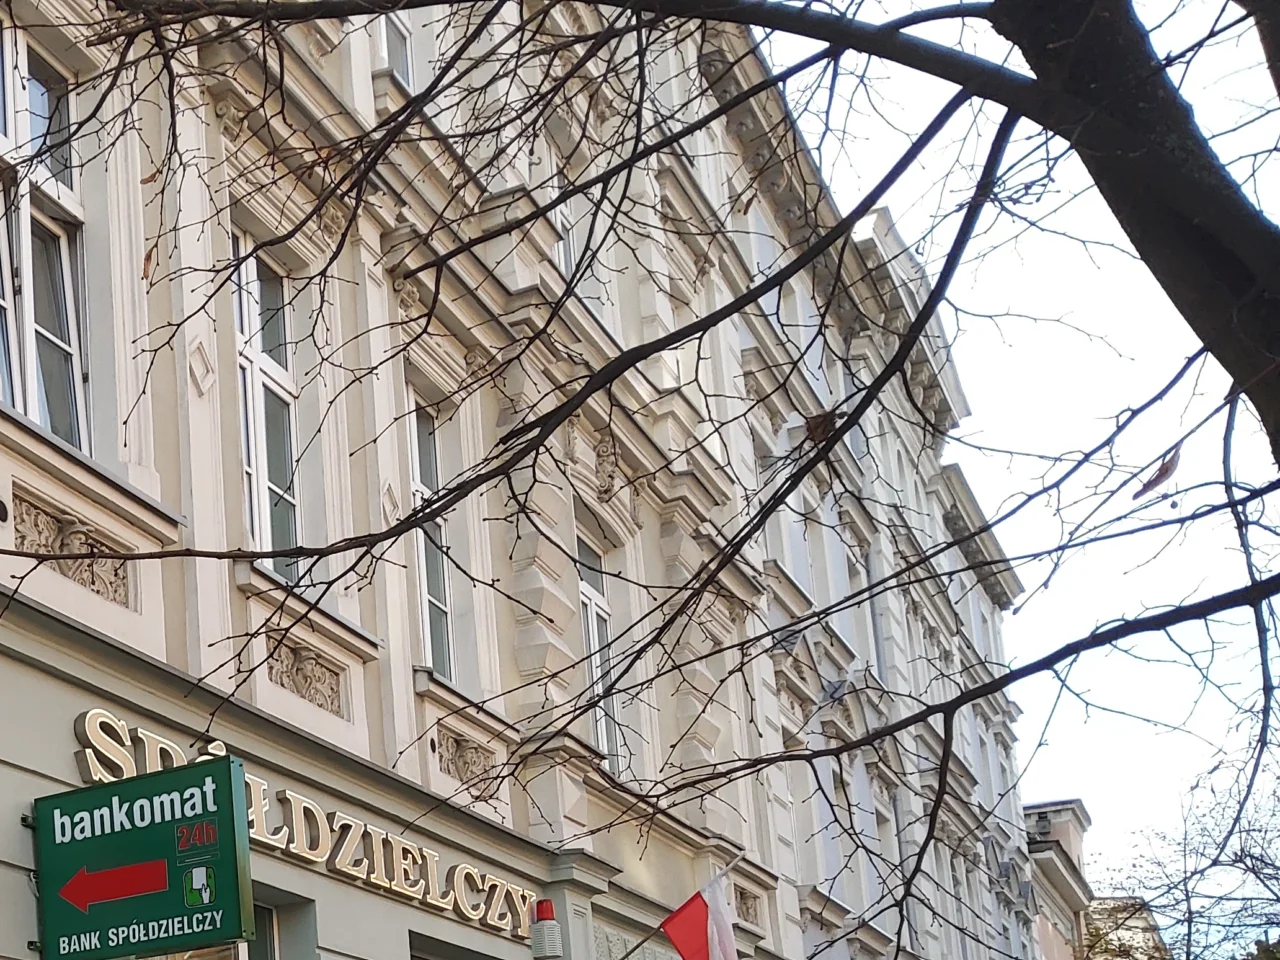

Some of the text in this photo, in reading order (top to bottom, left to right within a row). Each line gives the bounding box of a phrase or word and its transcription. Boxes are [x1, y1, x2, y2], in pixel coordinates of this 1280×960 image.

[53, 776, 218, 845] bankomat
[75, 708, 536, 939] SPŁDZIELCZY
[177, 821, 217, 850] 24h
[59, 909, 223, 954] BANK SPÓŁDZIELCZY
